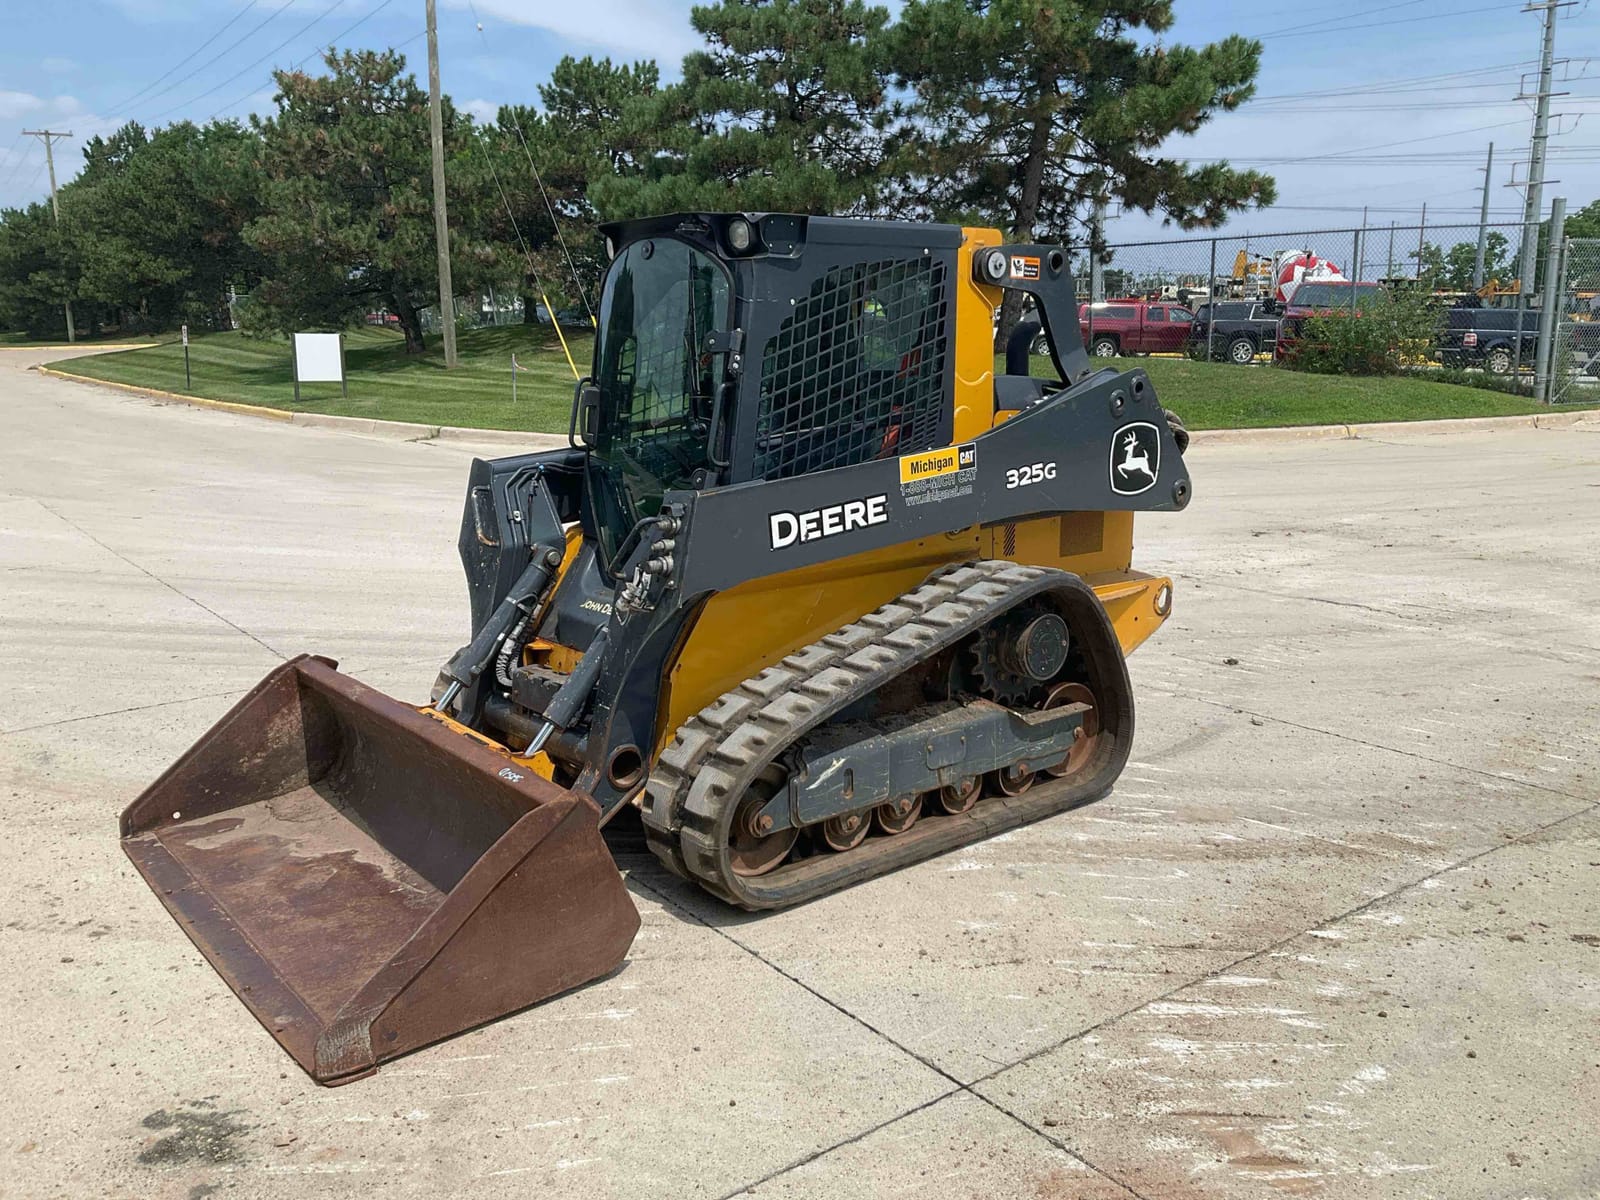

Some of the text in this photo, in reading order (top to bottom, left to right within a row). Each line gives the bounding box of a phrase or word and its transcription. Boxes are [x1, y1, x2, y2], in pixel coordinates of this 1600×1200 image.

[910, 450, 975, 475] Michigan CAT
[957, 468, 977, 483] CAT
[1006, 462, 1056, 489] 325G
[770, 495, 888, 549] DEERE
[580, 600, 603, 612] JOHN
